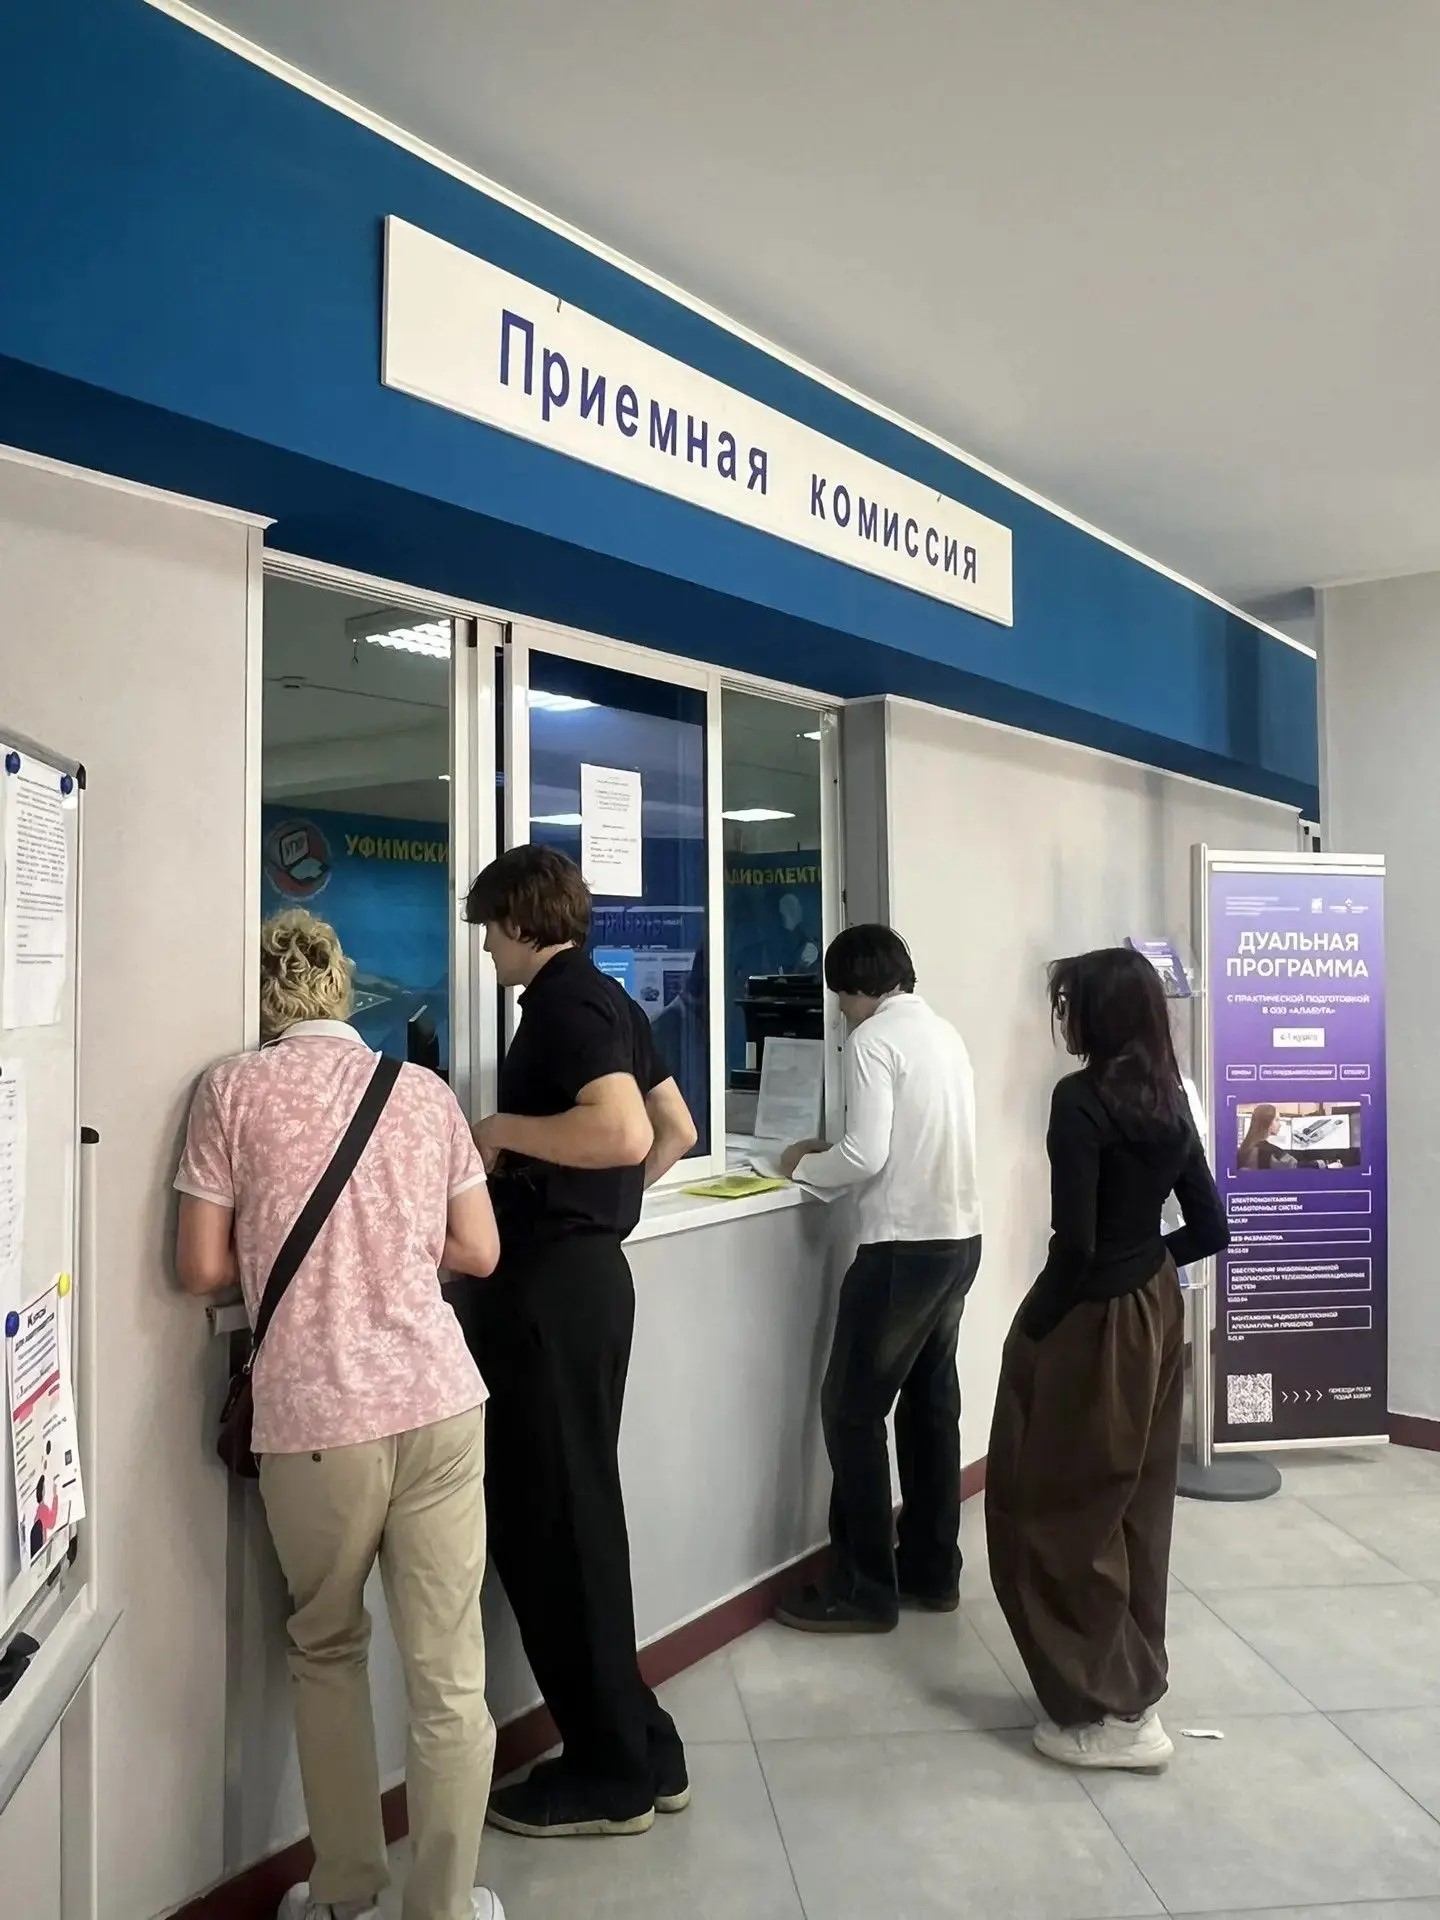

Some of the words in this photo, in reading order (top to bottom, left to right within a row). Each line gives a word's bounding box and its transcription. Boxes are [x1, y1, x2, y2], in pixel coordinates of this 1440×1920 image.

[500, 308, 768, 496] Приемная
[811, 473, 978, 584] комиссия
[1238, 932, 1359, 955] ДУАЛЬНАЯ
[1226, 958, 1369, 978] ПРОГРАММА
[1234, 994, 1304, 1003] ПРАКТИЧЕСКОЙ
[1305, 994, 1370, 1004] ПОДГОТОВКОЙ
